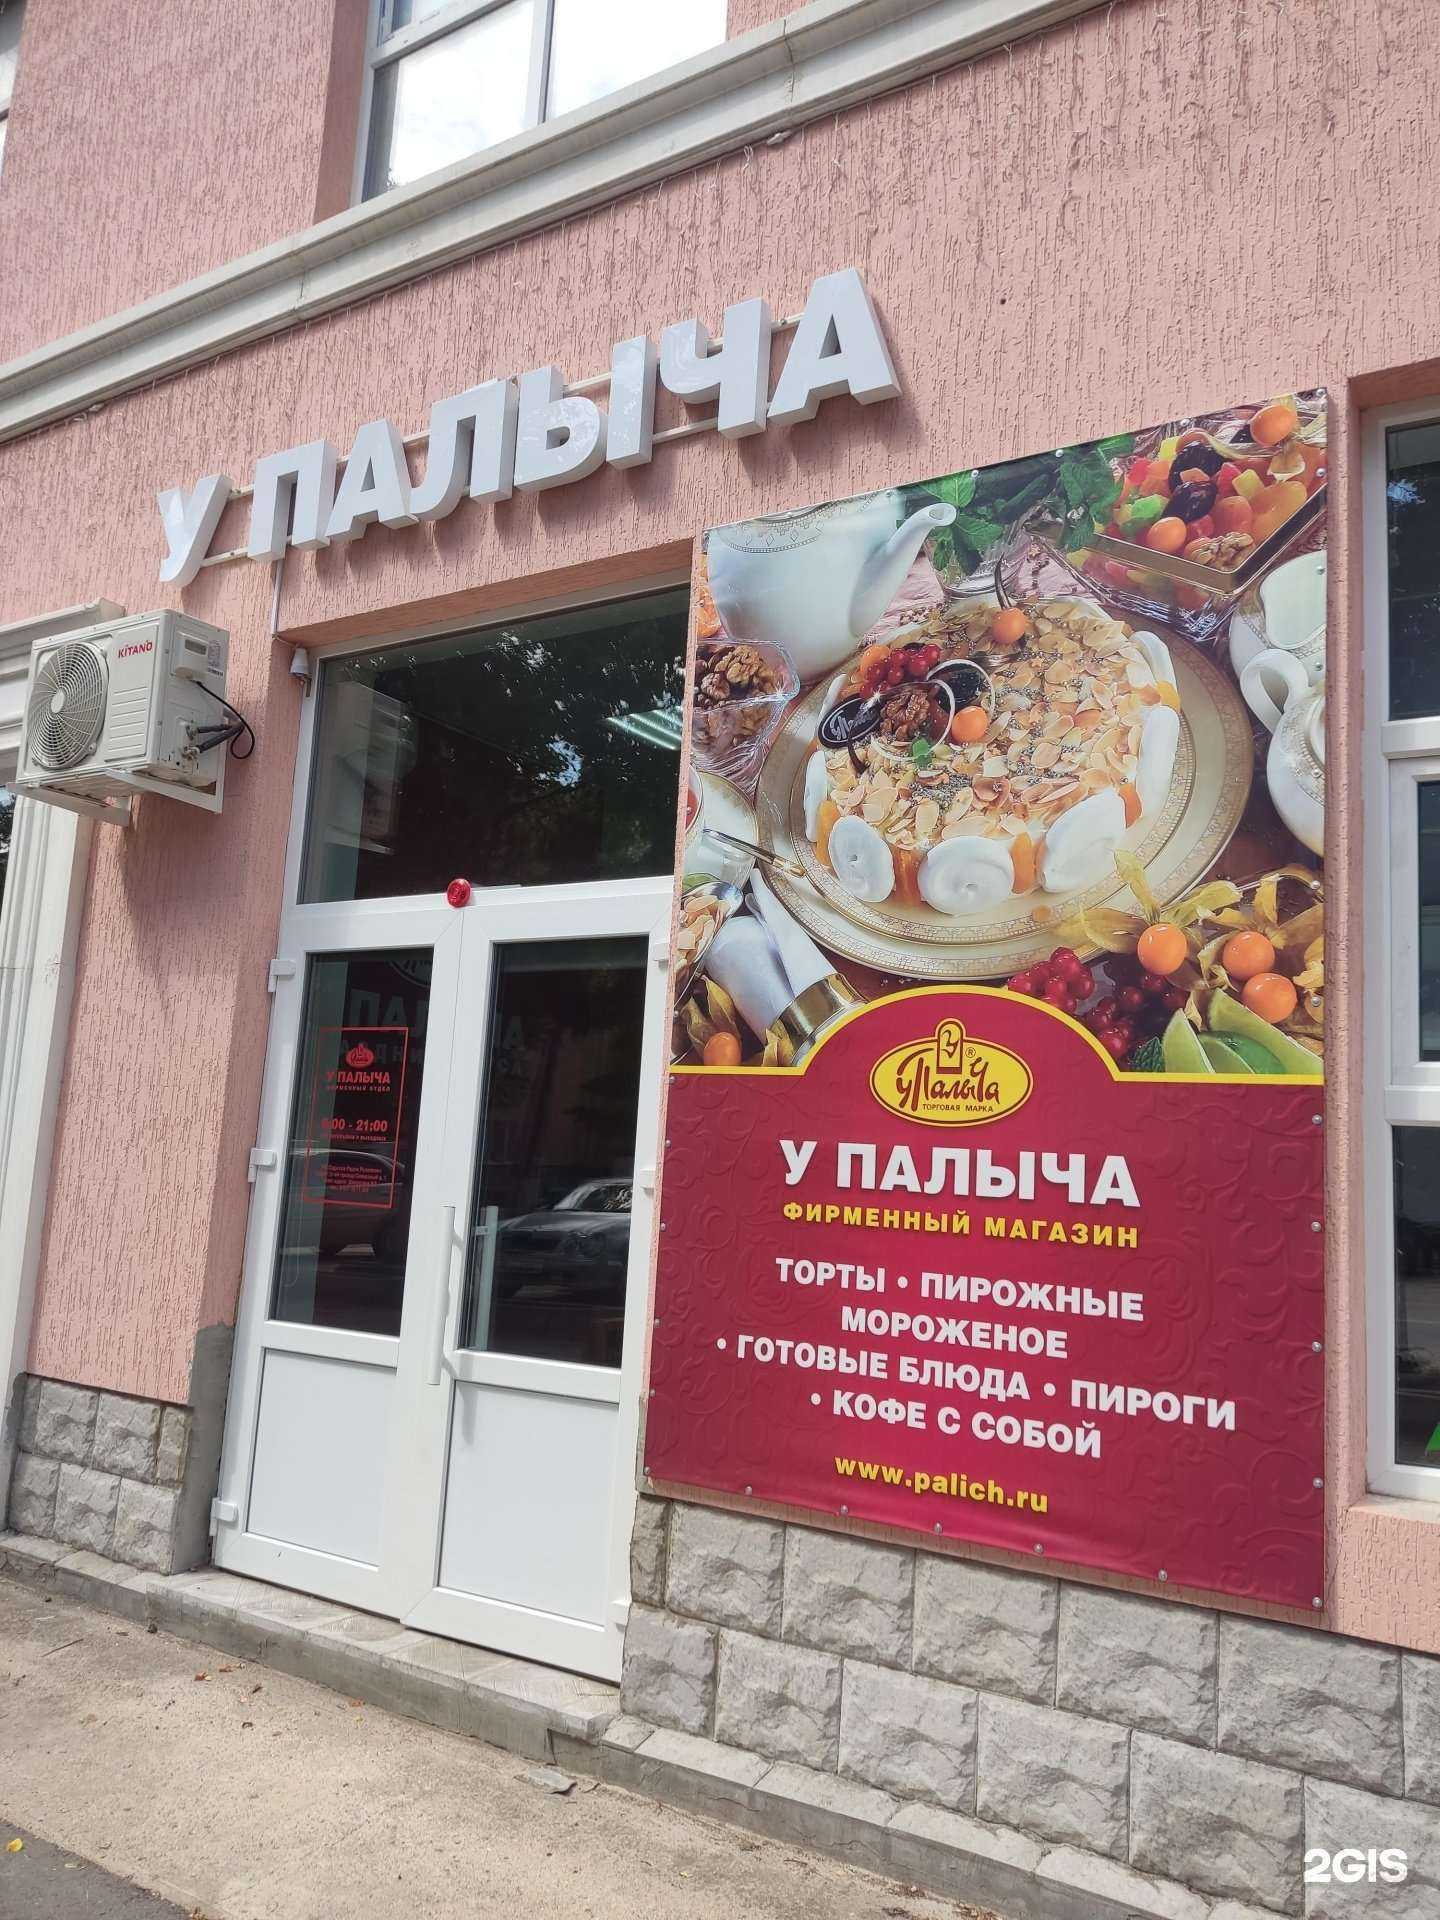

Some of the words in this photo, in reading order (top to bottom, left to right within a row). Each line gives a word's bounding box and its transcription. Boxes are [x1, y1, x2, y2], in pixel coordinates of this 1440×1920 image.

[158, 474, 231, 588] У
[247, 267, 902, 562] ПАЛЫЧА
[337, 1071, 391, 1084] ПАЛЫЧА
[356, 1119, 388, 1132] 21:00
[922, 1103, 961, 1112] ТОРГОВАЯ
[965, 1105, 994, 1113] МАРКА
[779, 1139, 818, 1186] У
[837, 1142, 1141, 1208] ПАЛЫЧА
[783, 1202, 970, 1235] ФИРМЕННЫЙ
[984, 1216, 1138, 1249] МАГАЗИН
[776, 1257, 886, 1294] ТОРТЫ
[921, 1272, 1145, 1323] ПИРОЖНЫЕ
[841, 1305, 1068, 1360] МОРОЖЕНОЕ
[737, 1334, 888, 1380] ГОТОВЫЕ
[899, 1356, 1031, 1403] БЛЮДА
[1071, 1379, 1237, 1432] ПИРОГИ
[833, 1389, 927, 1430] КОФЕ
[937, 1406, 961, 1436] С
[971, 1411, 1102, 1459] СОБОЙ
[834, 1457, 1049, 1514] www.palich.ru
